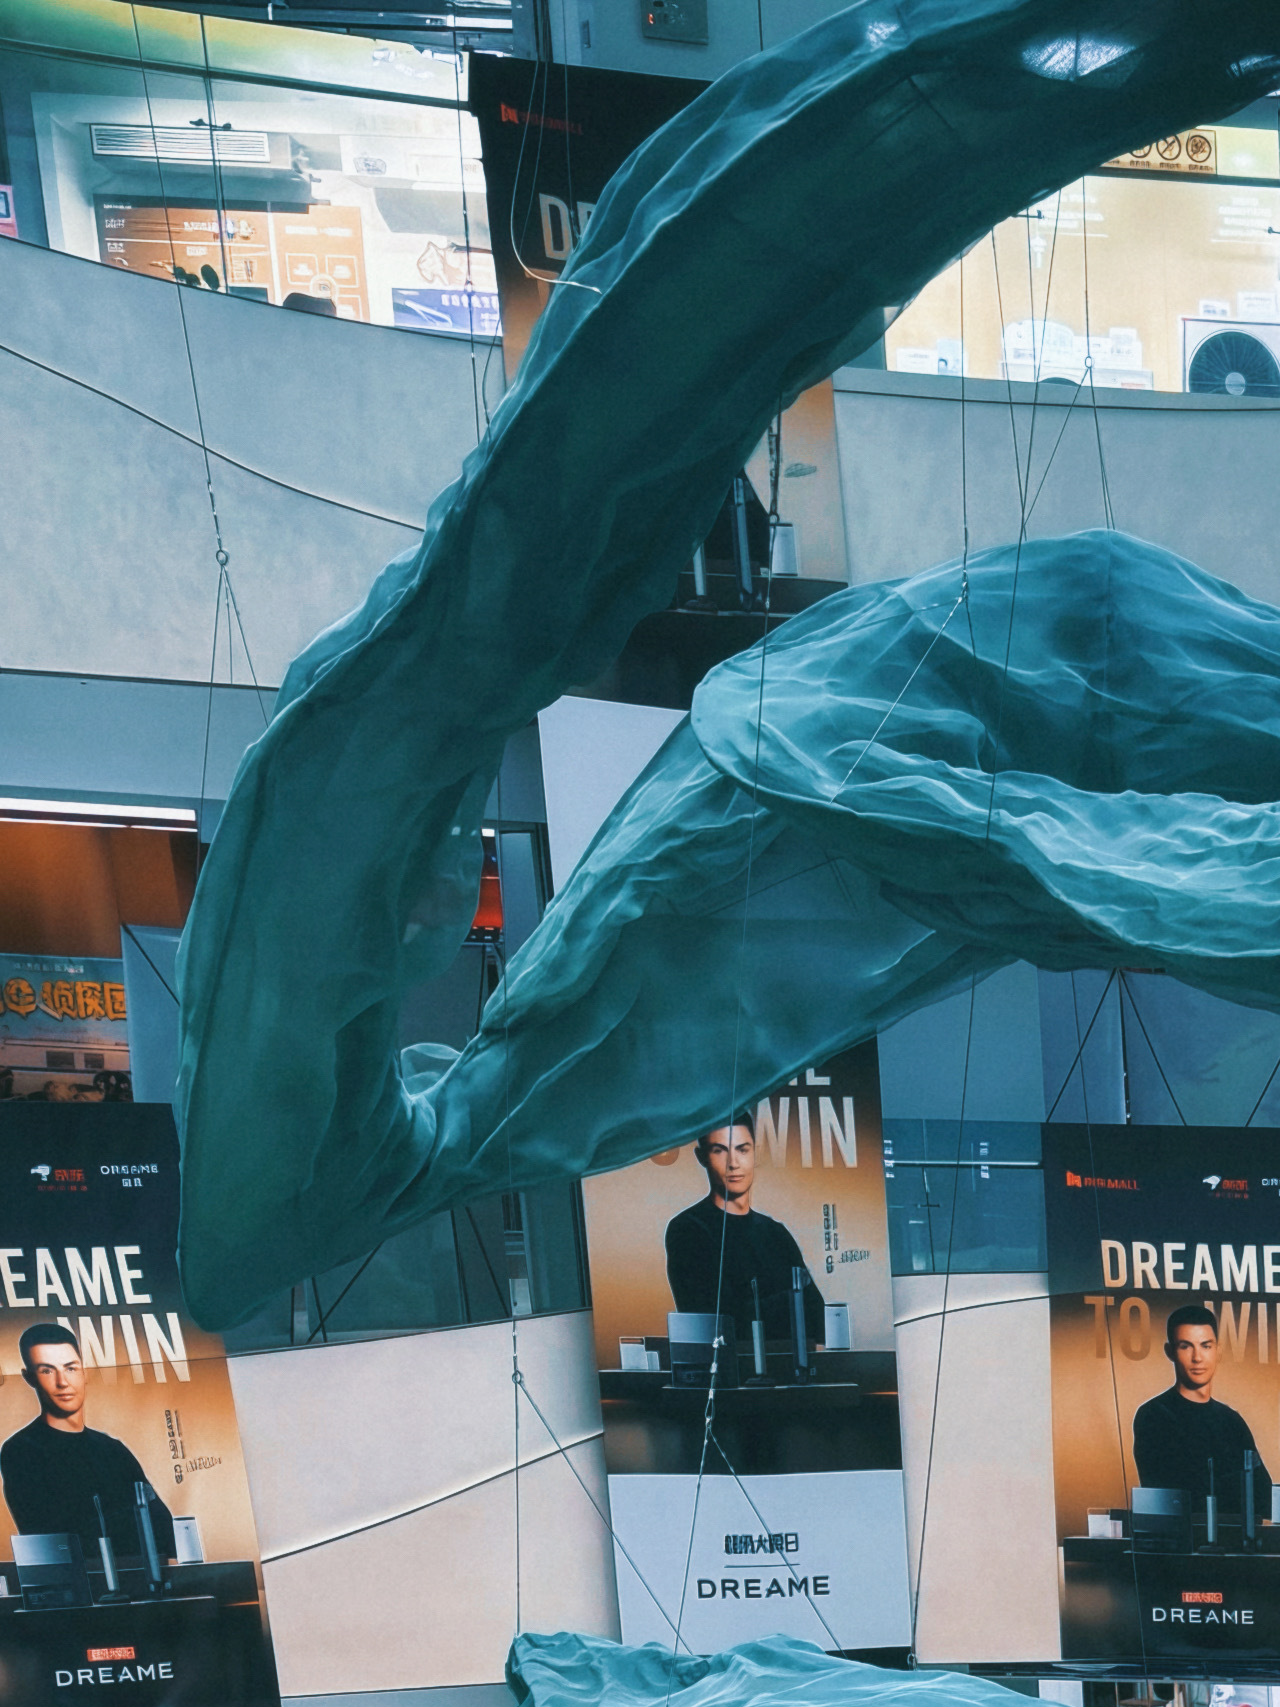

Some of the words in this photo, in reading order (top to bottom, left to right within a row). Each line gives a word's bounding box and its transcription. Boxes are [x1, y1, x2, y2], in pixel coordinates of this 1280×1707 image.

[0, 1245, 153, 1309] EAME
[58, 1312, 191, 1384] WIN
[1083, 1295, 1152, 1362] TO
[697, 1576, 831, 1600] DREAME
[1152, 1606, 1255, 1626] DREAME
[54, 1661, 175, 1689] DREAME
